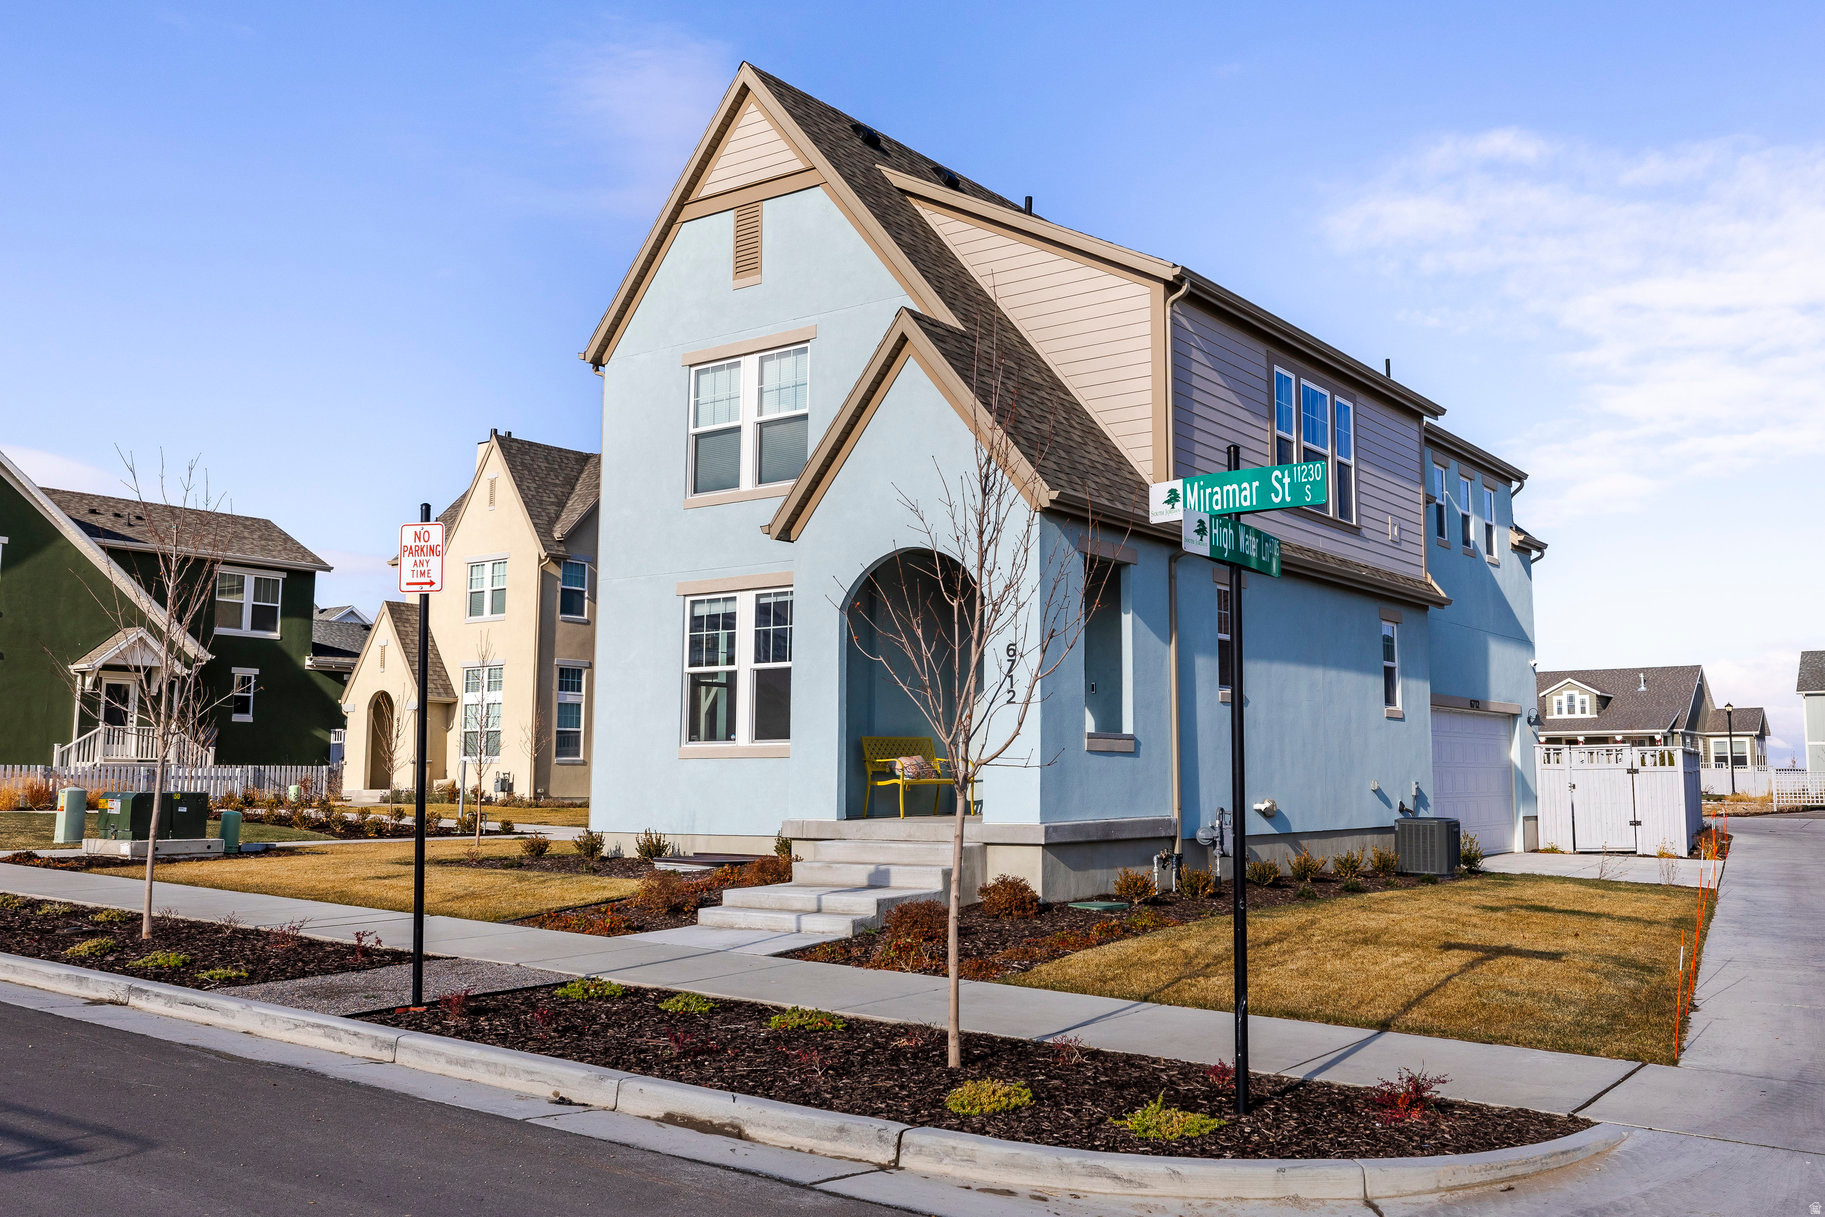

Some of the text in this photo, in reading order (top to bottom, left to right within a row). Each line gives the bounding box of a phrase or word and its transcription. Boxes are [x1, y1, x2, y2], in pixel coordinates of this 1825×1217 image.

[1293, 463, 1322, 483] 11230
[1186, 470, 1291, 513] Miramar St
[1304, 485, 1312, 502] S
[413, 530, 430, 543] NO
[1211, 517, 1270, 563] High Water Ln
[402, 544, 441, 558] PARKING
[413, 558, 430, 568] ANY
[411, 569, 432, 579] TIME
